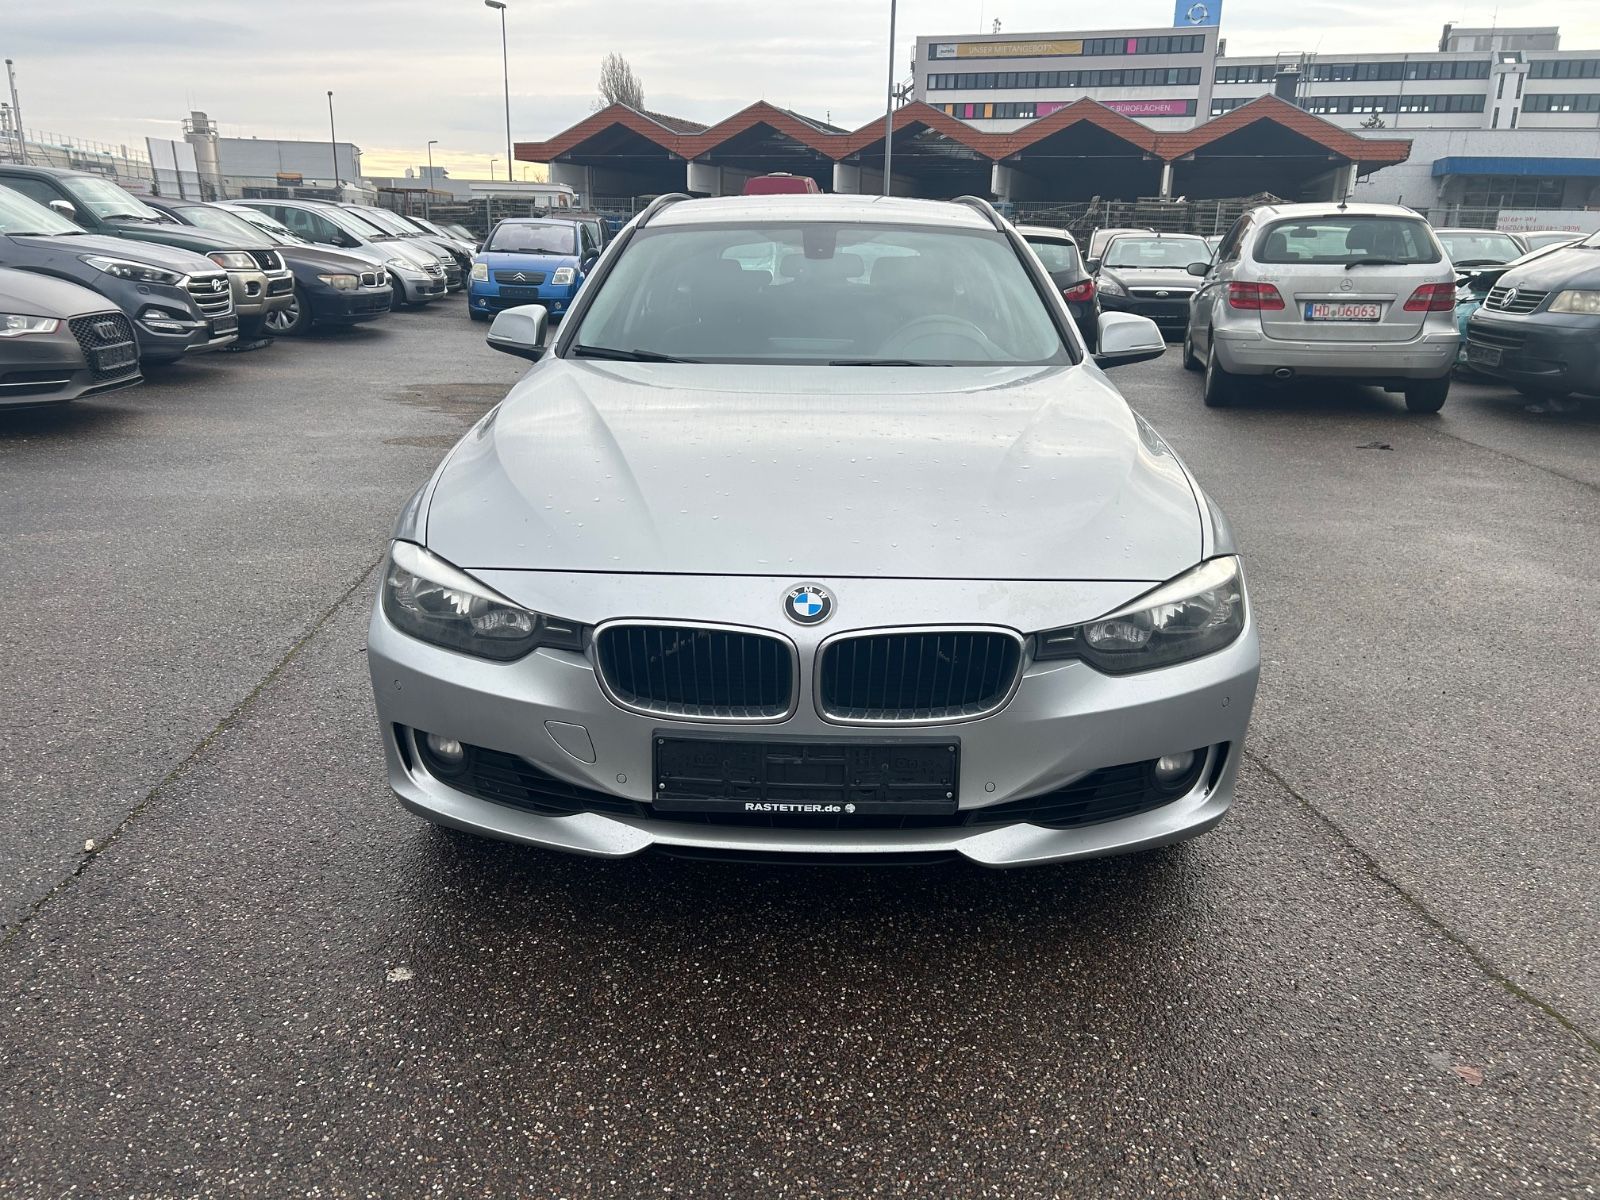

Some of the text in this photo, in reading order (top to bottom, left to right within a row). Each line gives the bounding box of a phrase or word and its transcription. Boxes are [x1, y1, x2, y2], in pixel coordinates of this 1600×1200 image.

[969, 46, 992, 54] UNSER
[1314, 305, 1330, 317] HD
[790, 586, 828, 599] BMW
[744, 802, 842, 813] RASTETTER.de
